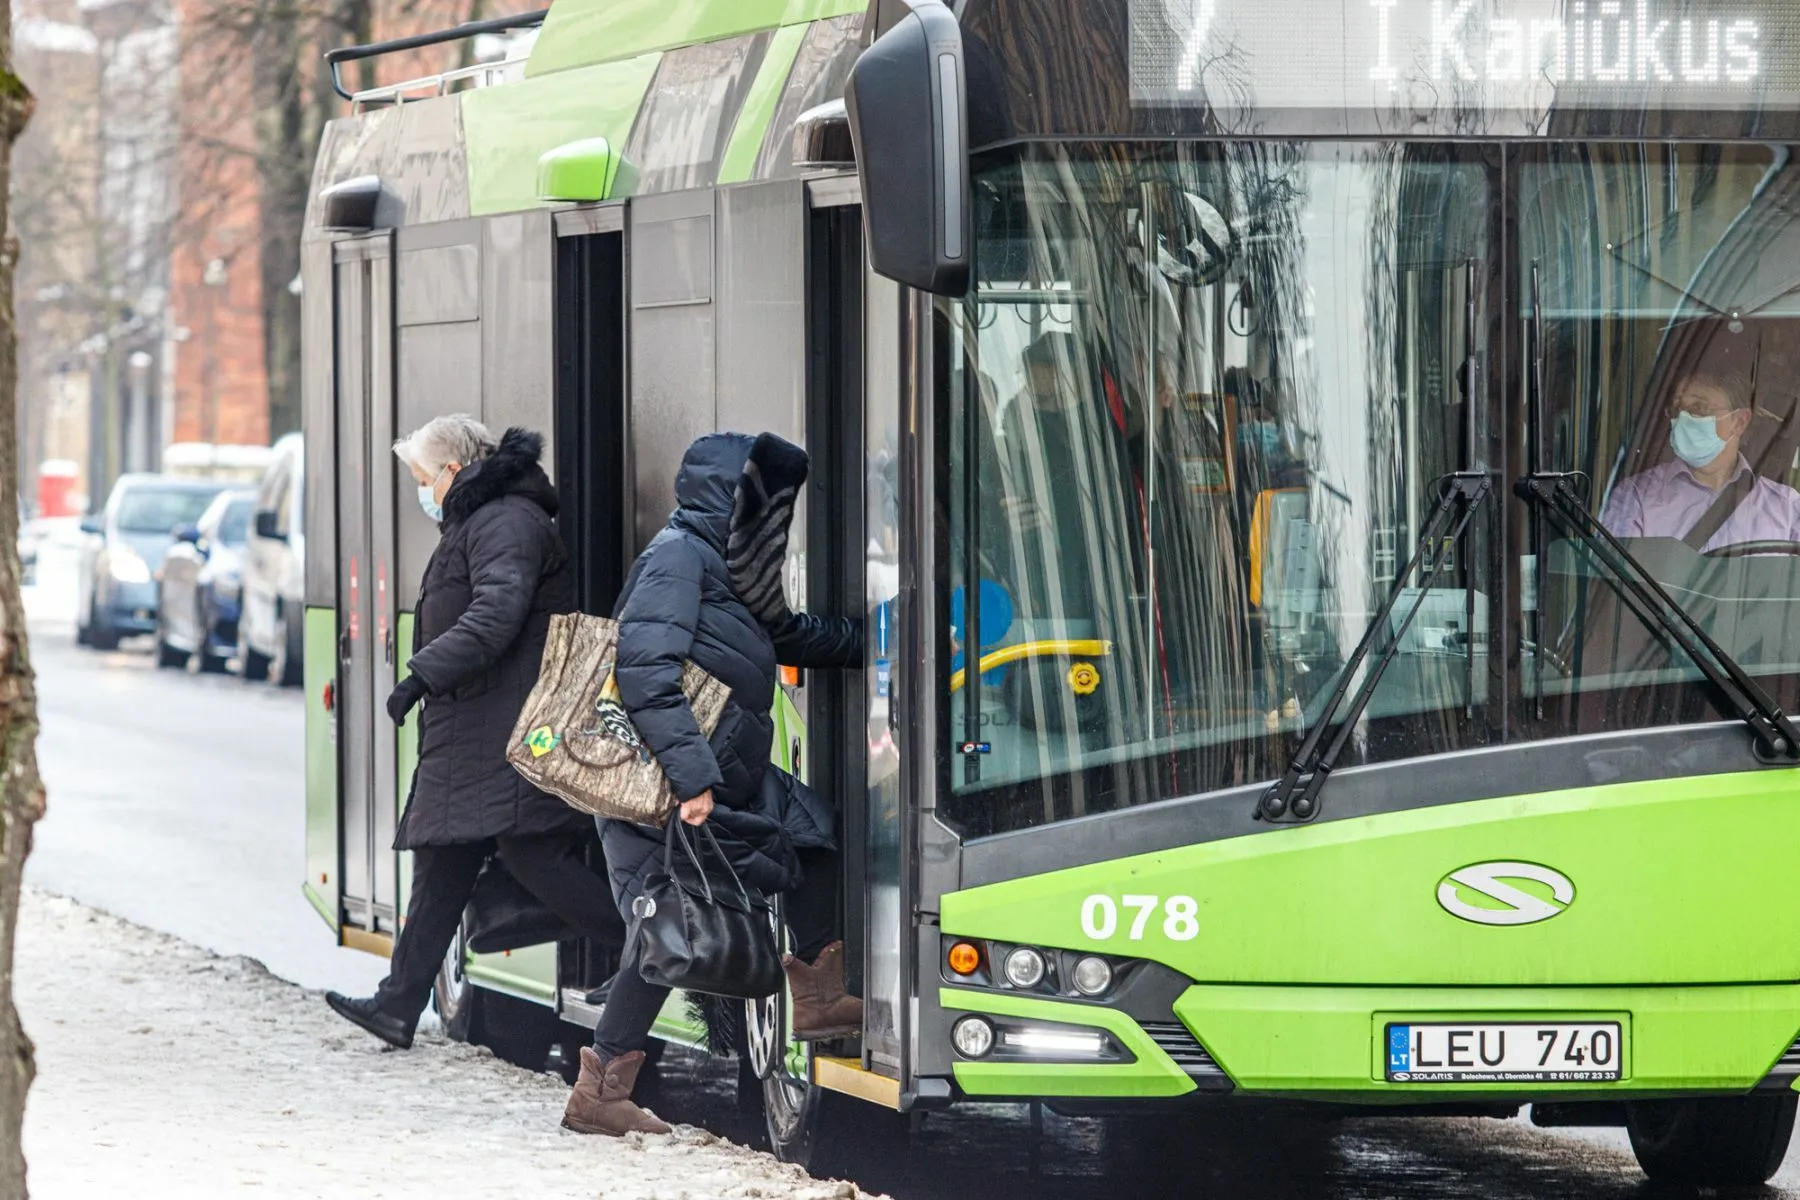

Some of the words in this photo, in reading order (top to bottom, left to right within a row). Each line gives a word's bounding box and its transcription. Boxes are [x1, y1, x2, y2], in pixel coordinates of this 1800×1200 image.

[1432, 0, 1759, 82] Kaniūkus
[1080, 894, 1200, 942] 078
[1391, 1053, 1408, 1065] LT
[1415, 1030, 1505, 1067] LEU
[1536, 1030, 1612, 1066] 740
[1411, 1072, 1454, 1080] SOLARIS
[1591, 1072, 1603, 1080] 23
[1604, 1072, 1616, 1080] 33
